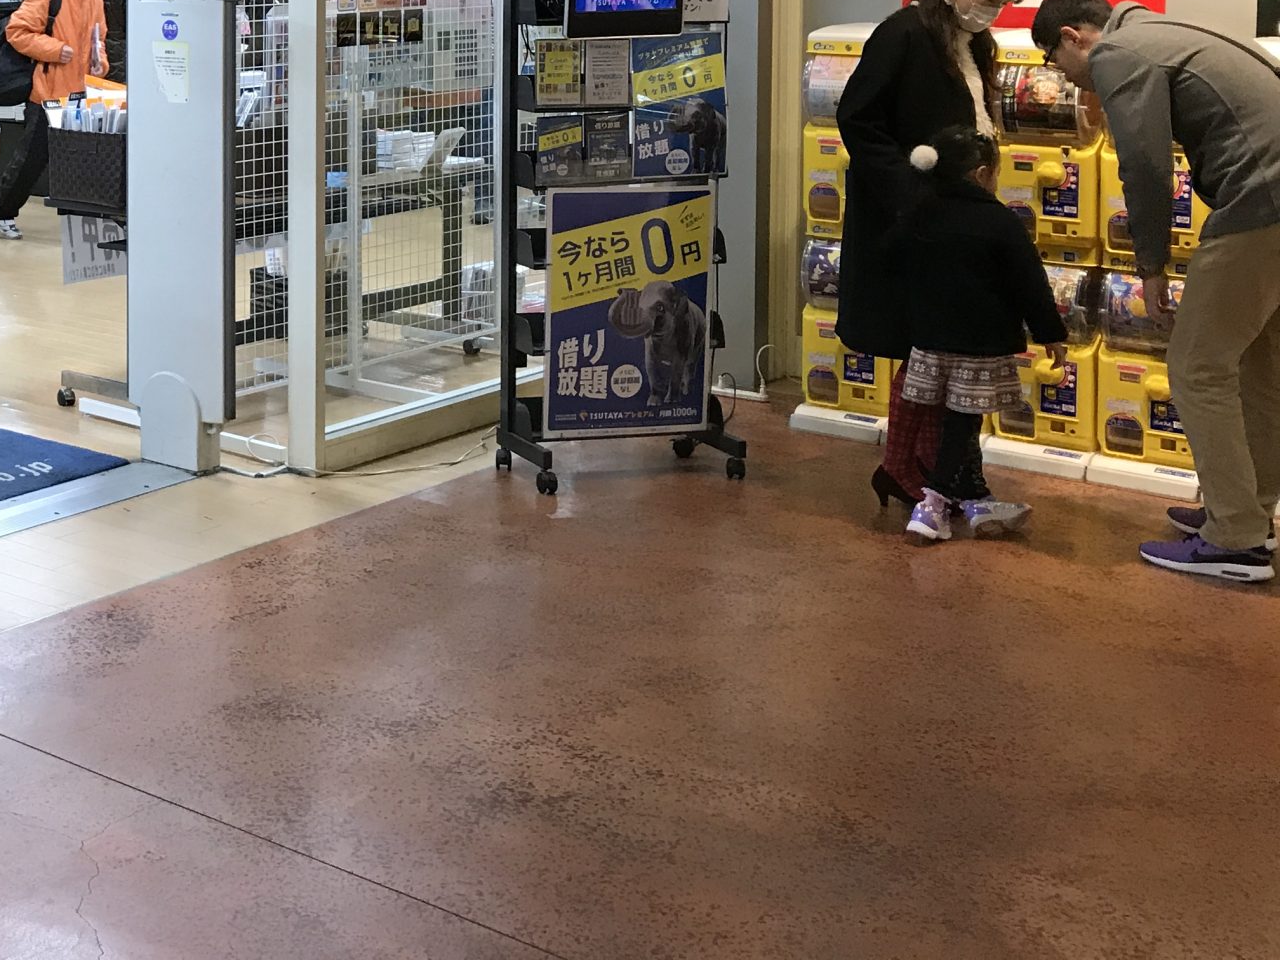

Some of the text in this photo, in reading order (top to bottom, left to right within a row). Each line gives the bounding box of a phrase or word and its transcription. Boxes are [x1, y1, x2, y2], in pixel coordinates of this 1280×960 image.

[164, 23, 177, 31] EAS
[647, 71, 674, 84] 今なら
[635, 120, 664, 141] 借り
[638, 139, 670, 160] 放題
[557, 232, 630, 266] 今なら
[562, 255, 636, 291] 1ヶ月間
[558, 329, 605, 369] 借り
[557, 364, 609, 400] 放題
[590, 412, 623, 421] TSUTAYA
